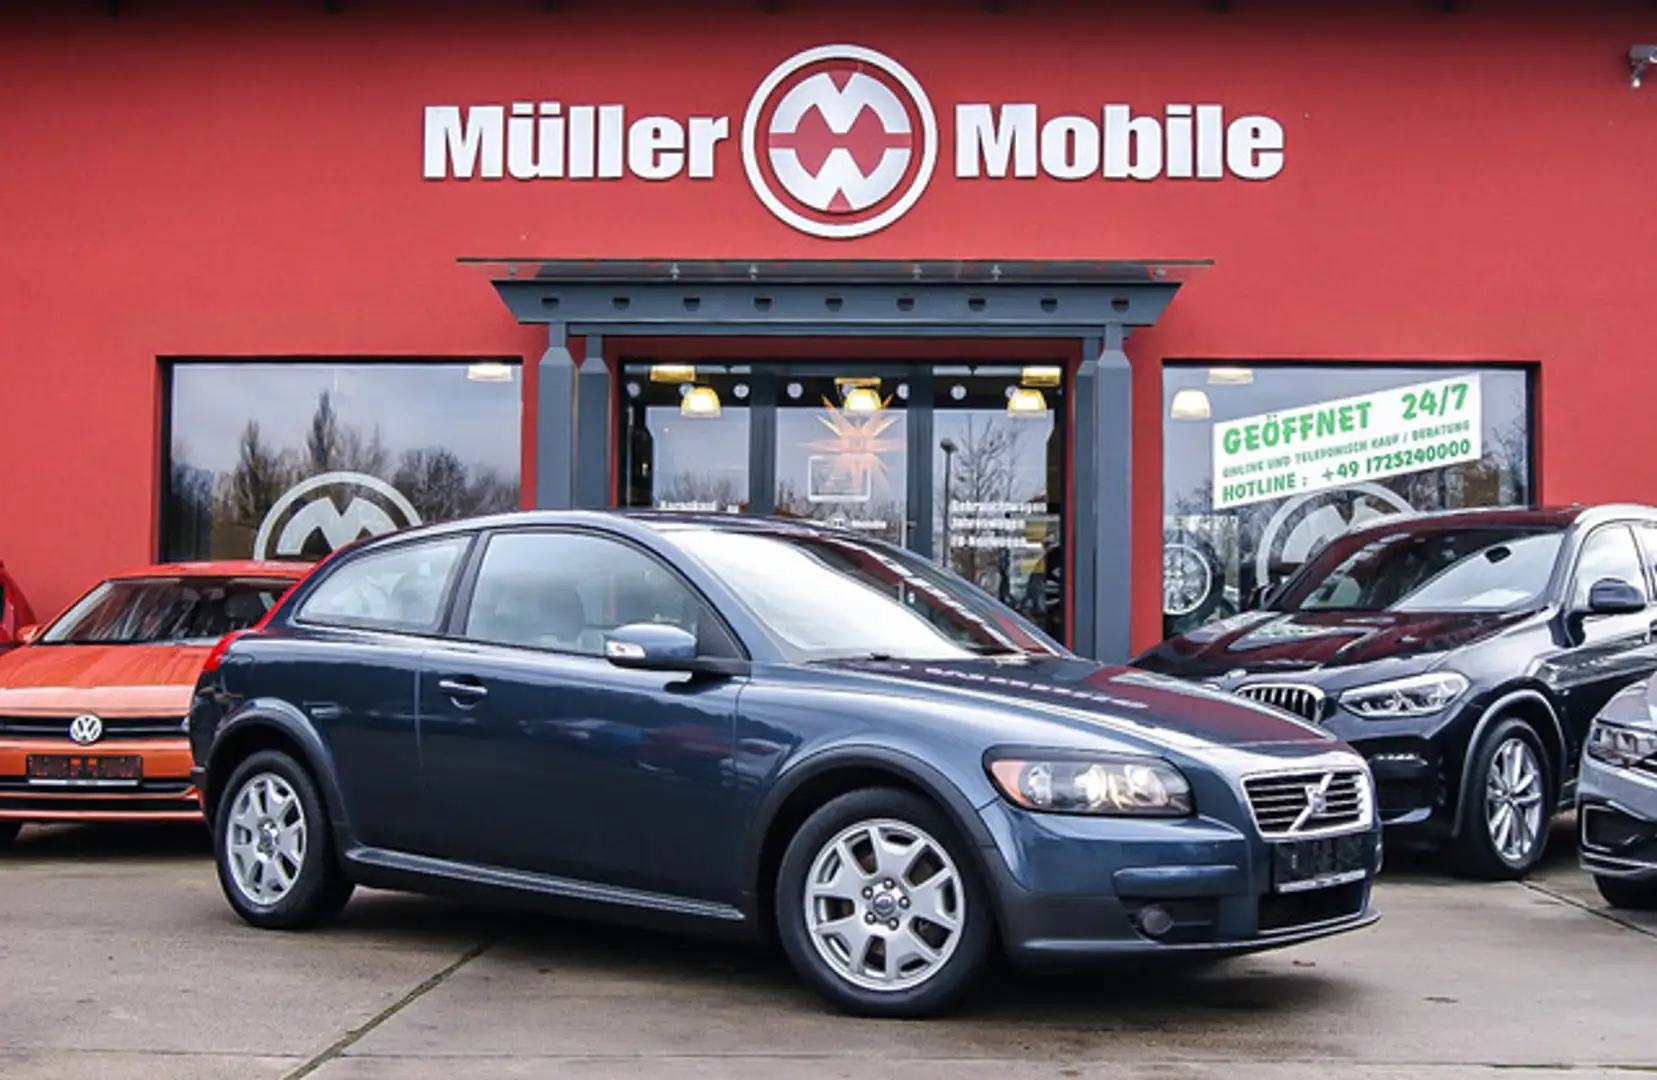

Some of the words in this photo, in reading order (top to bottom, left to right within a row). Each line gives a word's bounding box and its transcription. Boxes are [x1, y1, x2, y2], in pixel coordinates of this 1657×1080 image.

[423, 102, 729, 179] Müller
[955, 103, 1284, 180] Mobile
[1223, 401, 1372, 455] GEÖFFNET
[1401, 383, 1469, 420] 24/7
[1222, 472, 1296, 502] HOTLINE
[1321, 461, 1360, 480] +49
